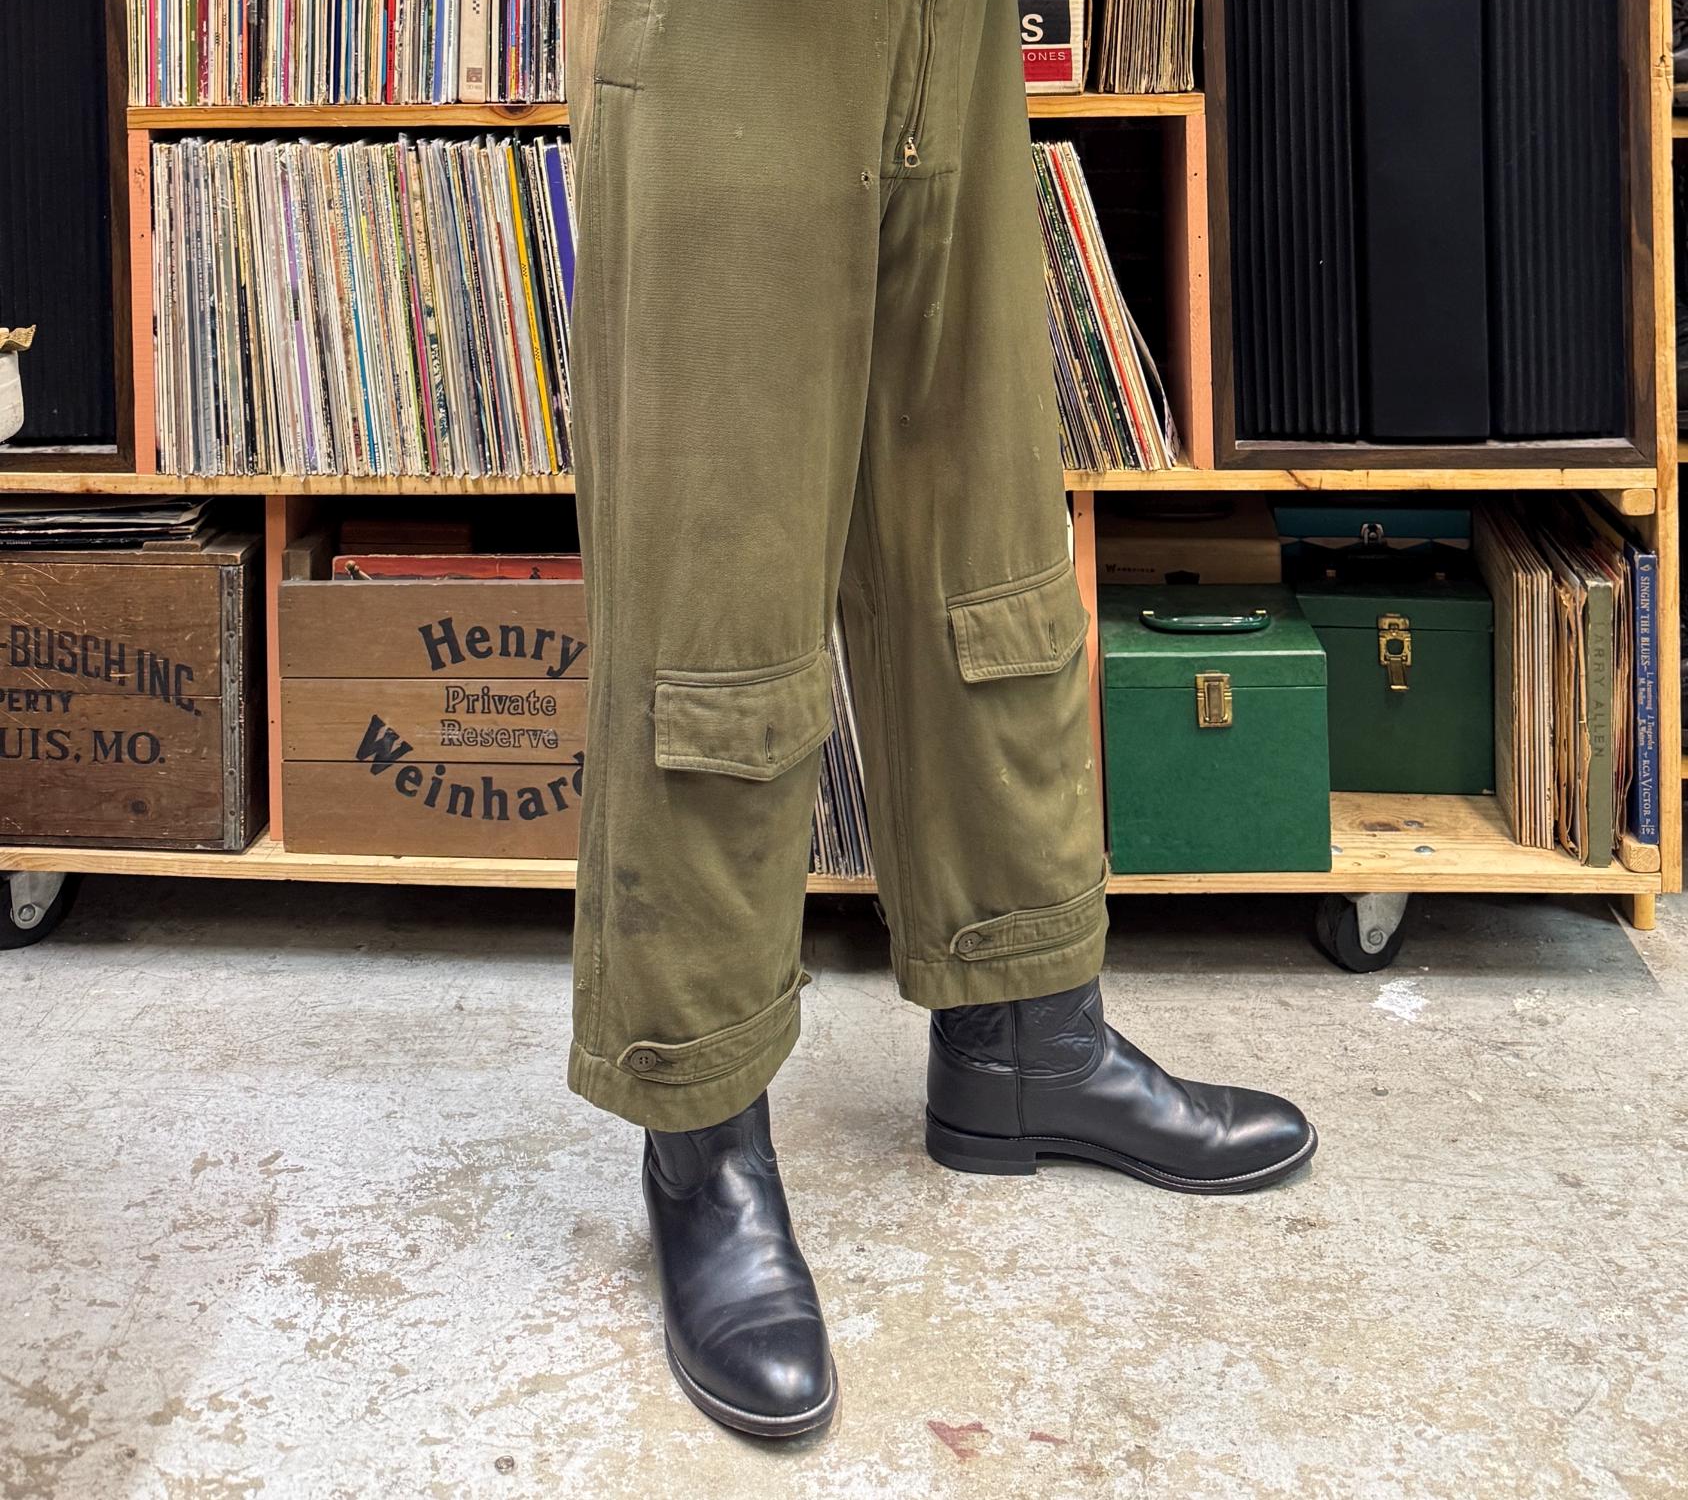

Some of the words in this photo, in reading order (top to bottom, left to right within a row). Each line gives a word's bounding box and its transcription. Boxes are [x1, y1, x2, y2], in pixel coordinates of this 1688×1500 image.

[1022, 13, 1045, 42] S
[1640, 576, 1651, 611] SINGIN'
[1640, 613, 1651, 634] THE
[418, 617, 588, 677] Henry
[137, 649, 202, 716] INC.
[445, 686, 557, 716] Private
[440, 719, 559, 749] Reserve
[1593, 701, 1605, 757] ALLEN
[92, 730, 166, 764] MO.
[1642, 759, 1650, 777] RCA
[1641, 778, 1652, 816] VICTOR
